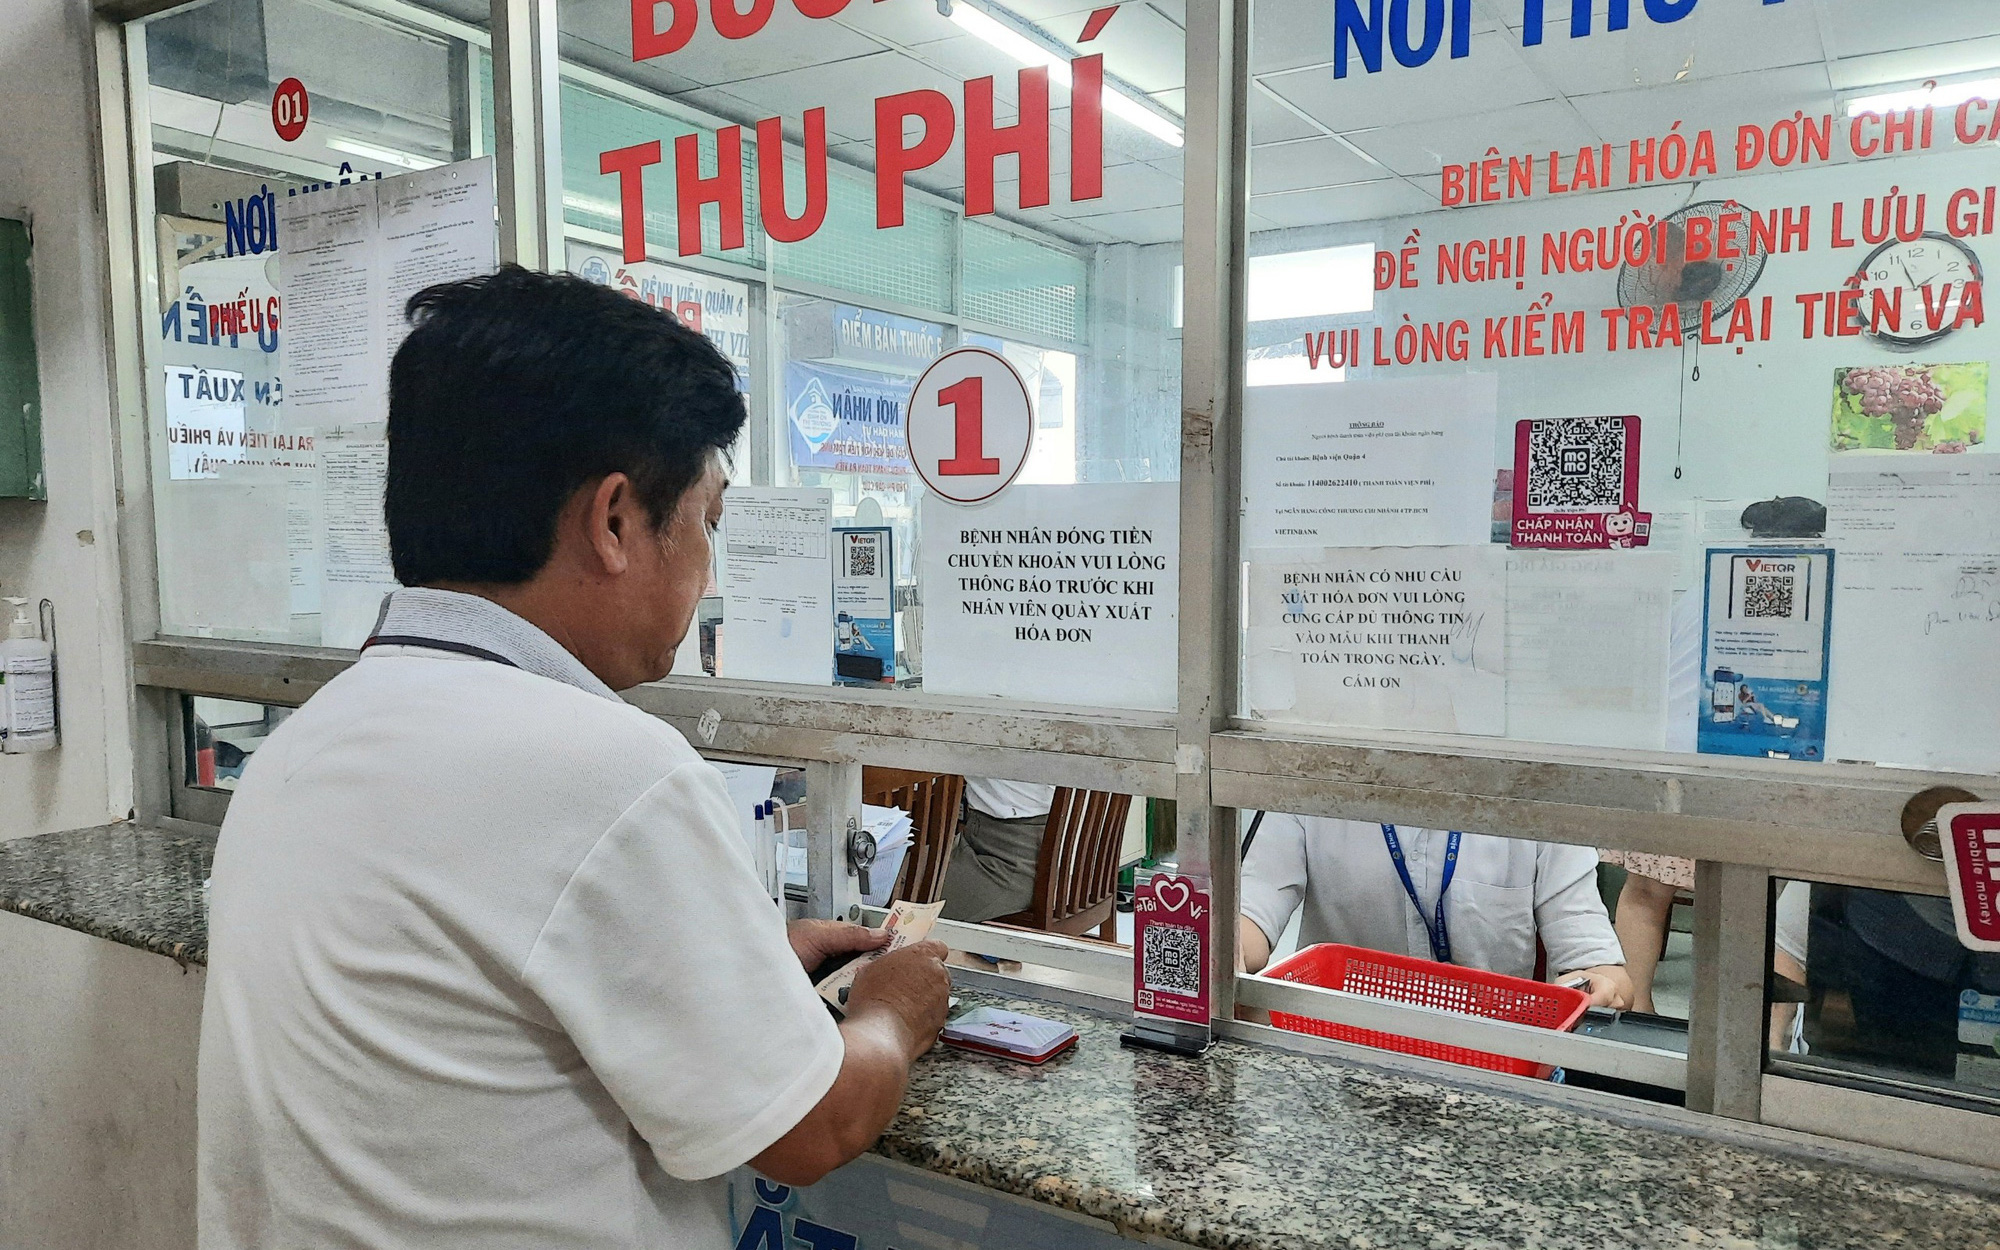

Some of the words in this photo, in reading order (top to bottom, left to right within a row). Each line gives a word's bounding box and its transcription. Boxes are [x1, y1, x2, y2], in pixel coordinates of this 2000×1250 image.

[278, 91, 303, 125] 01
[599, 106, 828, 264] THU
[874, 5, 1119, 230] PHÍ
[1440, 149, 1533, 207] BIÊN
[1547, 142, 1611, 195] LAI
[1628, 120, 1717, 184] HÓA
[1735, 109, 1833, 168] ĐƠN
[1850, 80, 1937, 157] CHỈ
[224, 185, 278, 258] NƠI
[1373, 228, 1420, 291] ĐỀ
[1436, 236, 1526, 292] NGHỊ
[1543, 211, 1667, 276] NGƯỜI
[1684, 202, 1809, 274] BỆNH
[1831, 185, 1924, 250] LƯU
[1908, 248, 1924, 258] 12
[209, 287, 260, 337] PHIẾU
[705, 289, 734, 316] QUẬN
[736, 297, 743, 317] 4
[1305, 332, 1360, 370] VUI
[1373, 305, 1470, 366] LÒNG
[1484, 292, 1585, 358] KIỂM
[1600, 307, 1683, 353] TRA
[1700, 297, 1773, 356] LẠI
[1796, 272, 1903, 340] TIỀN
[1921, 263, 1985, 332] VÀ
[1911, 320, 1922, 330] 6
[841, 309, 871, 349] ĐIỂM
[875, 321, 897, 354] BÁN
[900, 325, 935, 359] THUỐC
[938, 376, 999, 476] 1
[1517, 515, 1552, 530] CHẤP
[1555, 516, 1594, 533] NHẬN
[960, 528, 1002, 546] BỆNH
[1006, 525, 1052, 544] NHÂN
[1056, 525, 1105, 545] ĐÓNG
[1110, 525, 1153, 544] TIỀN
[1516, 532, 1562, 543] THANH
[1565, 531, 1603, 544] TOÁN
[948, 551, 1013, 569] CHUYỂN
[1018, 550, 1076, 570] KHOẢN
[1081, 555, 1112, 570] VUI
[1117, 551, 1166, 571] LÒNG
[958, 574, 1014, 592] THÔNG
[1019, 575, 1051, 593] BÁO
[1056, 576, 1118, 595] TRƯỚC
[1123, 581, 1154, 596] KHI
[1283, 572, 1321, 585] BỆNH
[1324, 570, 1365, 583] NHÂN
[1369, 569, 1390, 583] CÓ
[1395, 571, 1426, 583] NHU
[1430, 567, 1462, 582] CẦU
[1281, 590, 1319, 605] XUẤT
[1323, 590, 1354, 604] HÓA
[1358, 592, 1388, 604] ĐƠN
[1393, 592, 1418, 604] VUI
[1423, 588, 1466, 604] LÒNG
[962, 598, 1003, 616] NHÂN
[1009, 599, 1047, 617] VIÊN
[1051, 600, 1101, 620] QUẦY
[1105, 600, 1152, 621] XUẤT
[1282, 612, 1321, 624] CUNG
[1325, 610, 1354, 624] CẤP
[1381, 608, 1435, 624] THÔNG
[1439, 612, 1465, 624] TIN
[1015, 624, 1050, 642] HÓA
[1055, 627, 1093, 643] ĐƠN
[1295, 630, 1325, 645] VÀO
[1367, 632, 1393, 645] KHI
[1398, 632, 1450, 645] THANH
[1300, 649, 1340, 664] TOÁN
[1344, 652, 1394, 665] TRONG
[1400, 650, 1446, 666] NGÀY.
[1380, 675, 1401, 688] ƠN
[1966, 828, 1983, 876] mobile
[1976, 881, 1993, 927] money
